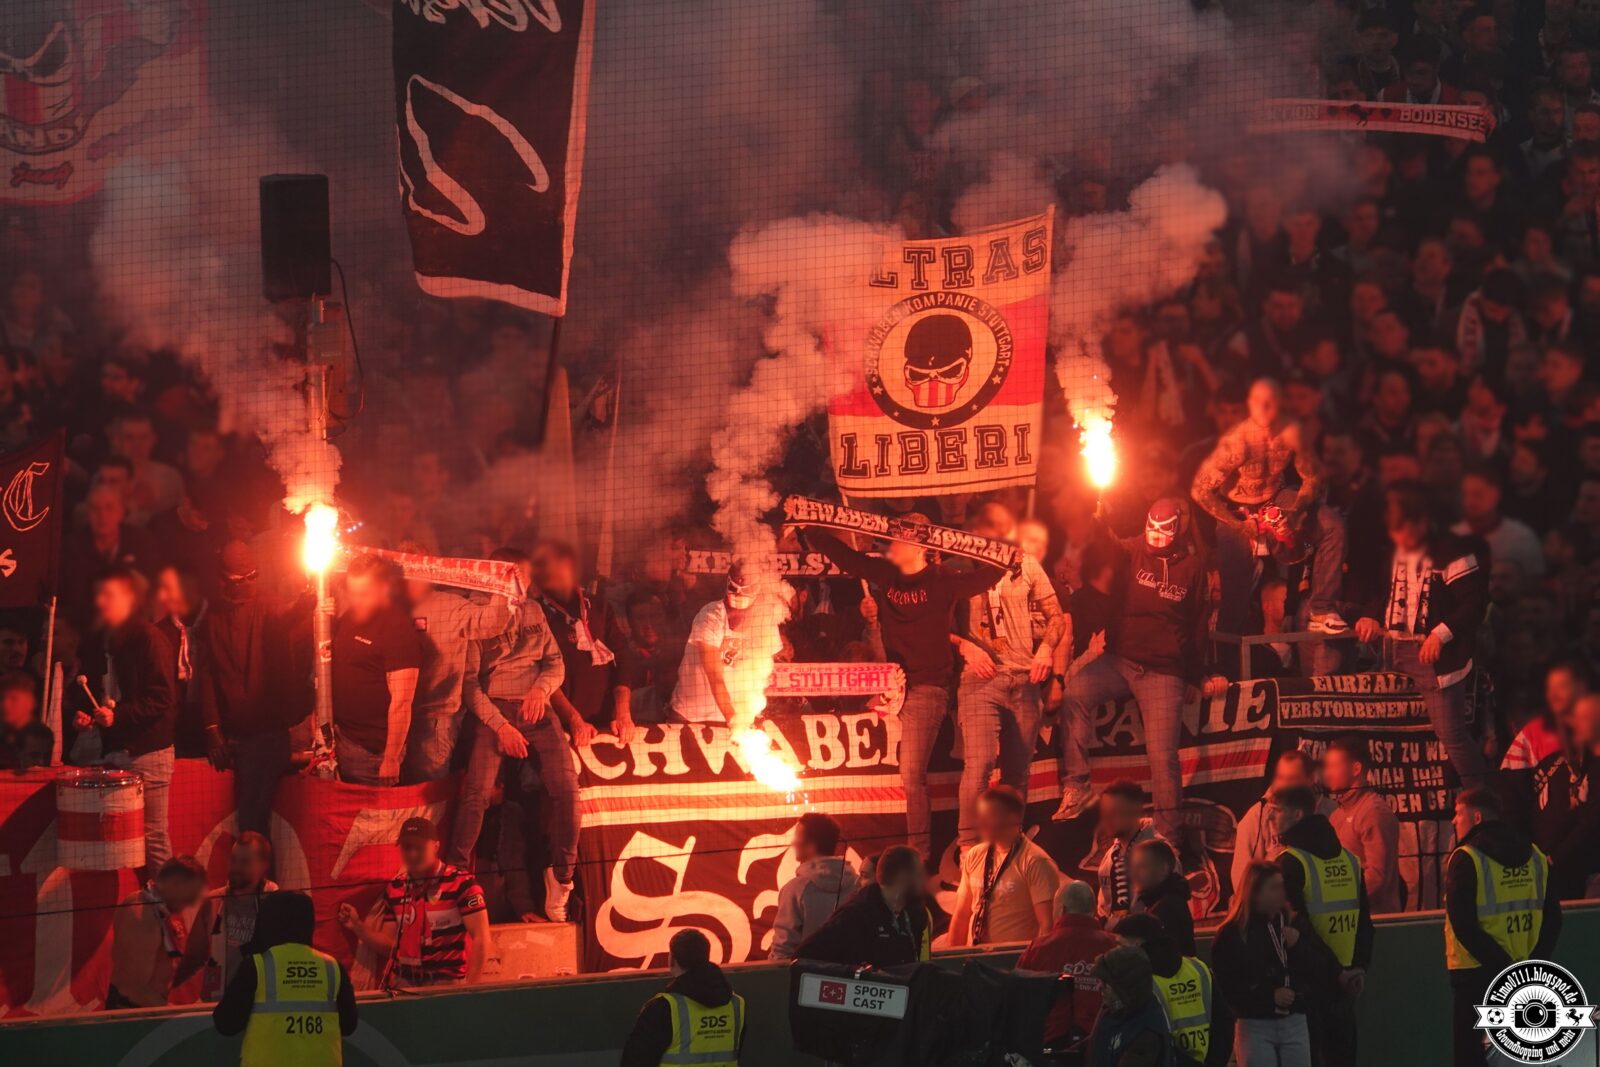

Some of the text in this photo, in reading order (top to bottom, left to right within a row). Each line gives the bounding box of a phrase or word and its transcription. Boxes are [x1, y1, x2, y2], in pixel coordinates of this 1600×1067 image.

[869, 226, 1048, 290] LTRAS
[901, 293, 977, 316] KOMPANIE
[977, 303, 1012, 367] STUTTGART
[838, 423, 1031, 479] LIBERI
[788, 497, 889, 533] CHWABEN
[789, 671, 891, 688] STUTTGART
[1280, 700, 1407, 719] VERSTORBENEN
[568, 712, 902, 780] CHWABE
[1368, 739, 1395, 763] IST
[1401, 741, 1420, 763] ZU
[1325, 865, 1347, 878] SDS
[286, 966, 319, 978] SDS
[854, 984, 896, 999] SPORT
[1168, 980, 1197, 995] SDS
[853, 997, 885, 1010] CAST
[286, 1016, 323, 1034] 2168
[700, 1015, 728, 1029] SDS
